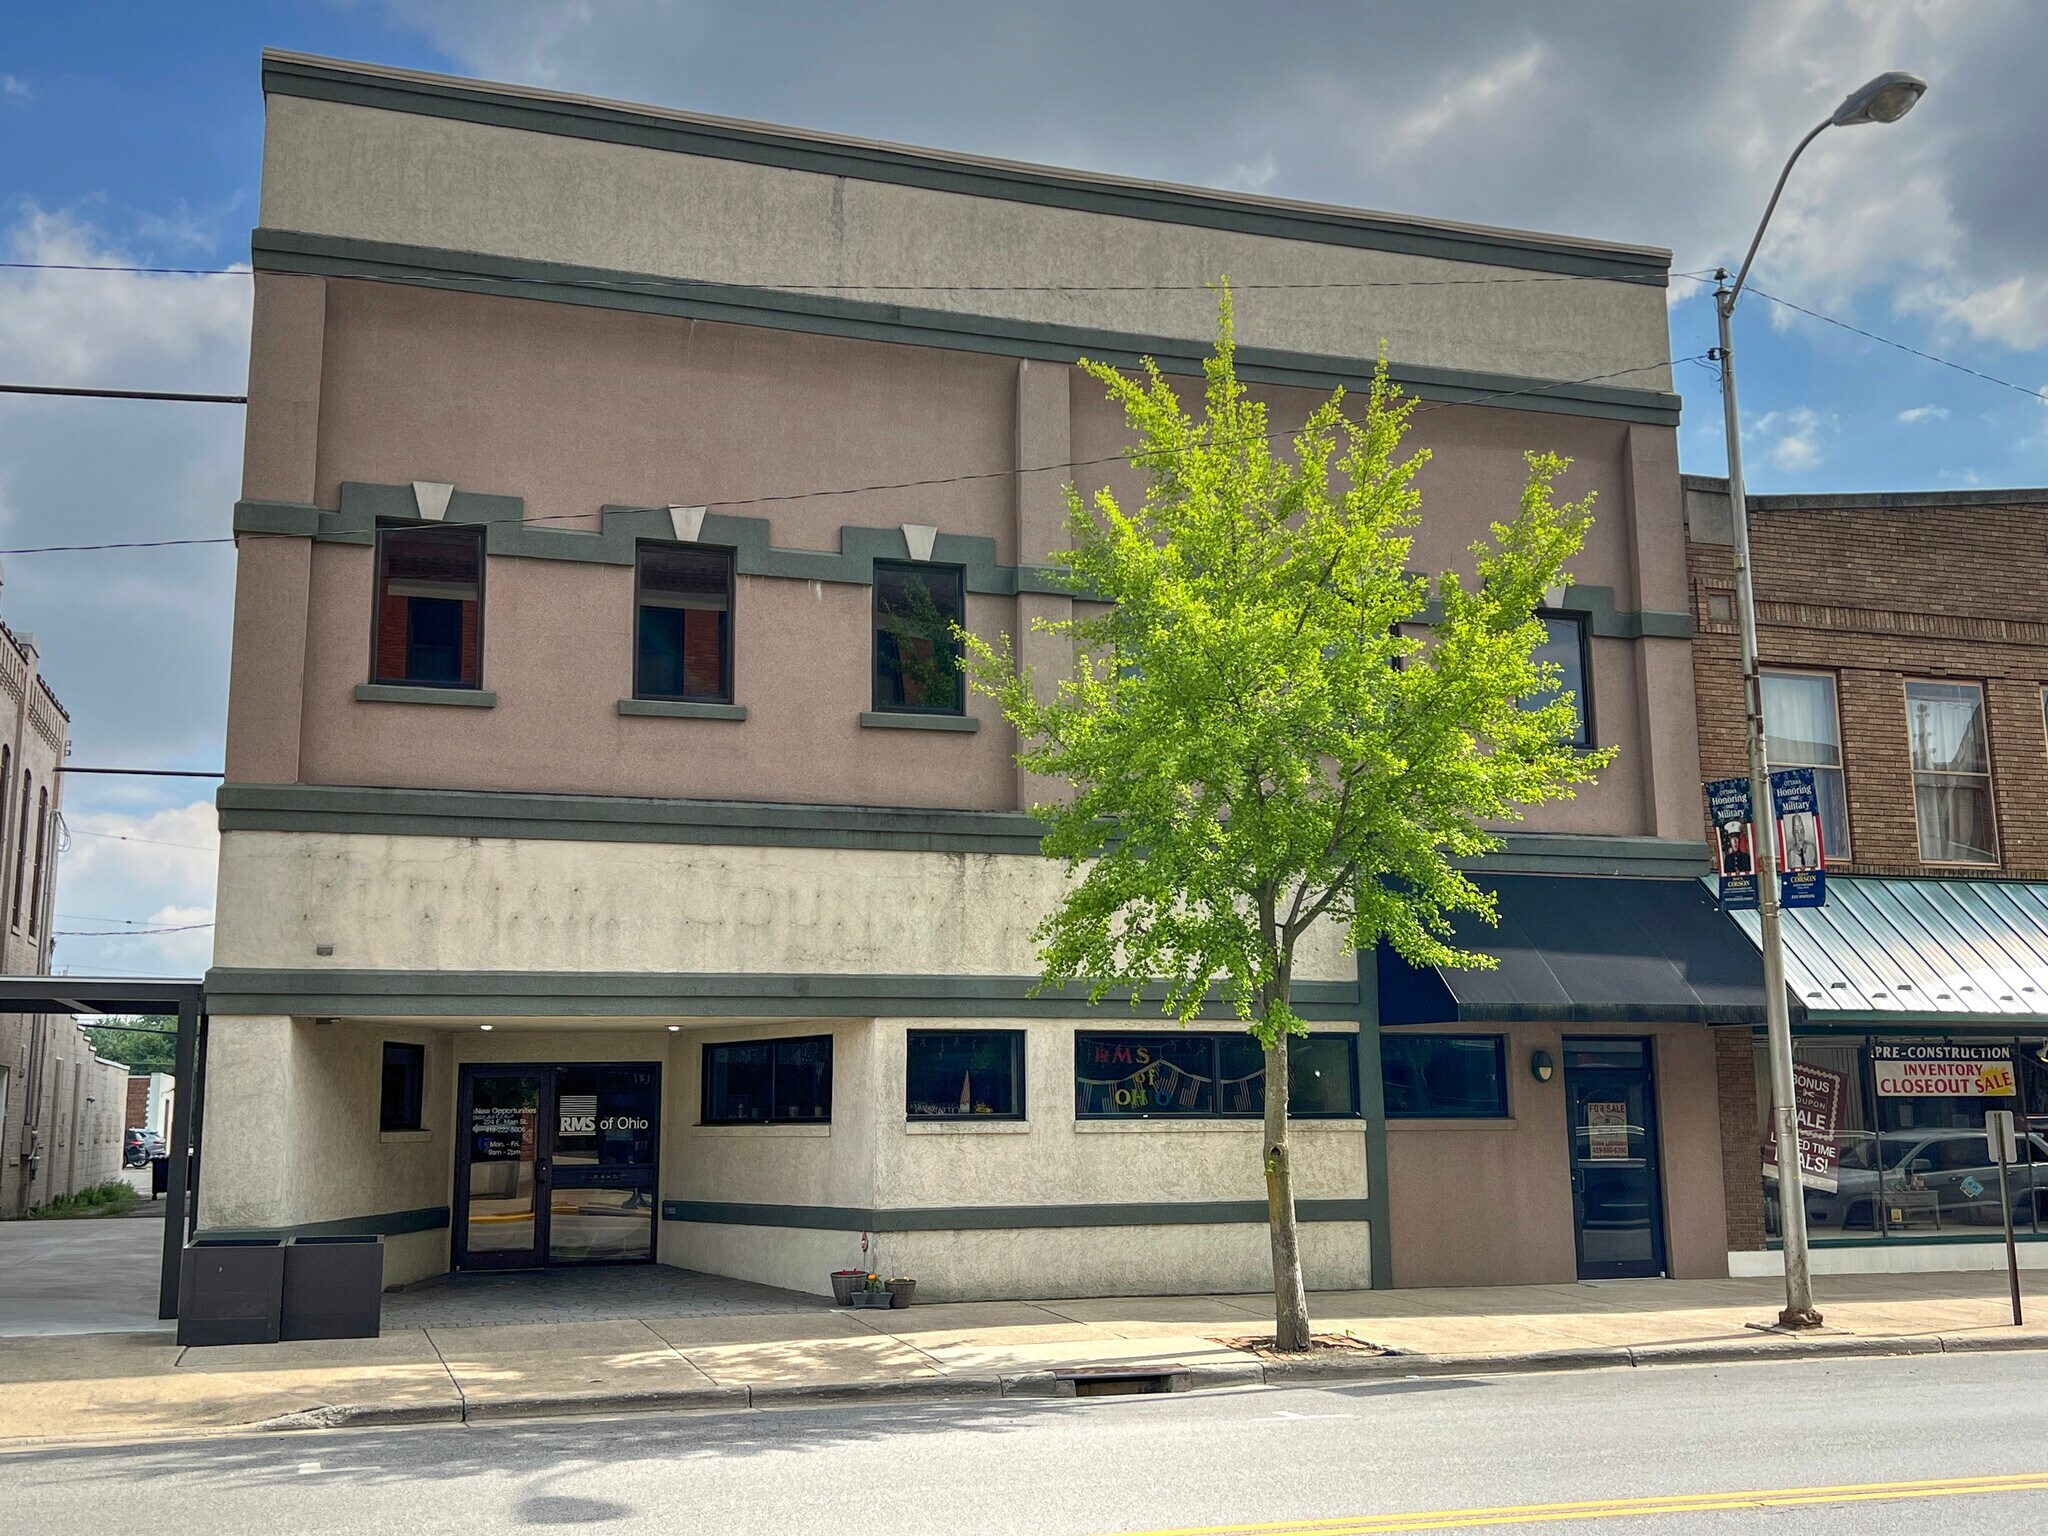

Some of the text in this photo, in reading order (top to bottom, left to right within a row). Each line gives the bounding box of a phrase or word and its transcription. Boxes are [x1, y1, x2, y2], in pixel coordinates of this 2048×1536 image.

[1777, 784, 1812, 797] Honoring
[1712, 793, 1748, 806] Honoring
[1782, 800, 1810, 811] Military
[1718, 808, 1745, 819] Military
[1875, 1045, 2011, 1059] PRE-CONSTRUCTION
[1903, 1063, 1984, 1077] INVENTORY
[1793, 1073, 1830, 1094] BONUS
[1880, 1071, 2012, 1094] CLOSEOUT SALE
[1589, 1104, 1625, 1113] FOR SALE
[1796, 1096, 1826, 1110] OUPON
[491, 1107, 537, 1116] Opportunities
[560, 1116, 649, 1132] RMS of Ohio
[1797, 1109, 1827, 1130] ALE
[1812, 1142, 1837, 1158] TIME
